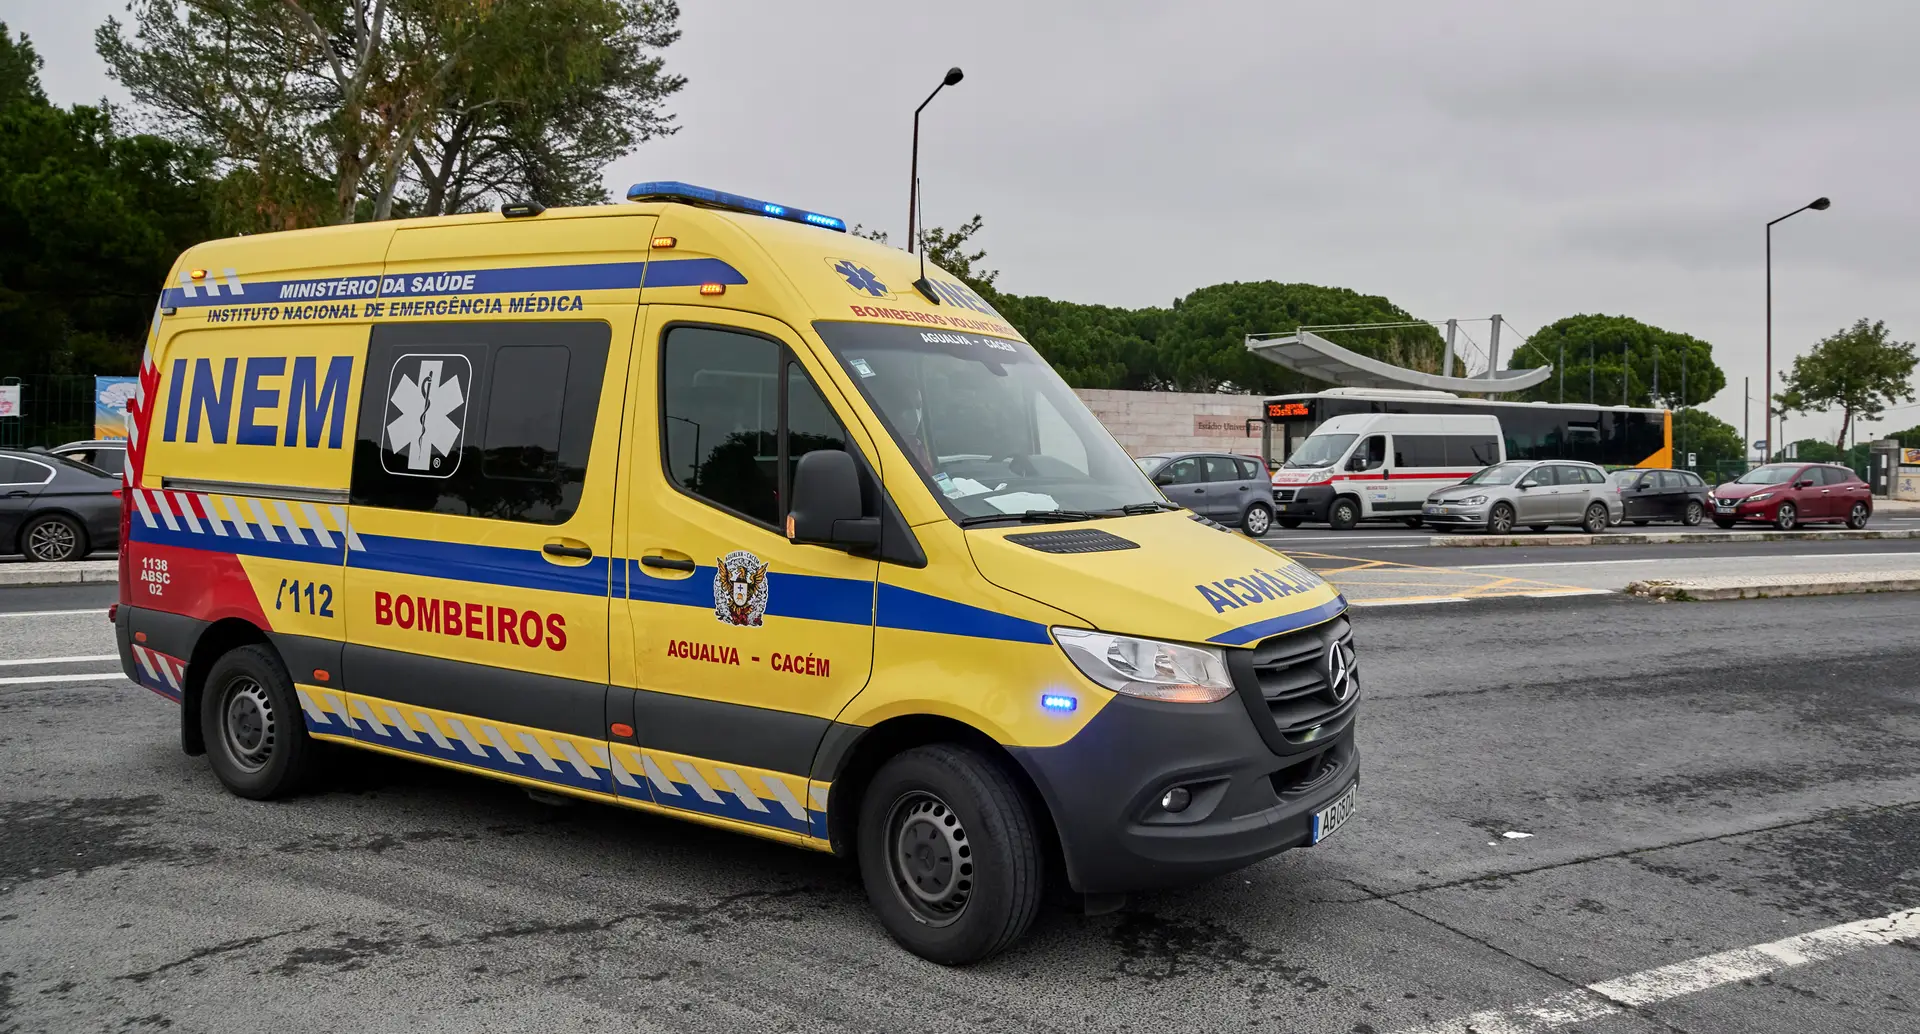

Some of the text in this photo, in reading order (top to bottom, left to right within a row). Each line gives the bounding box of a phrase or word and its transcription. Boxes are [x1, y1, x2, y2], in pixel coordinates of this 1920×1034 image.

[280, 273, 475, 298] MINISTÉRIO DA SAÚDE
[929, 278, 1001, 319] INE
[207, 293, 583, 322] INSTITUTO NACIONAL DE EMERGÊNCIA MÉDICA
[850, 305, 947, 325] BOMBEIROS
[920, 333, 972, 346] AGUALVA
[163, 356, 354, 449] INEM
[140, 570, 171, 584] ABSC
[142, 557, 168, 571] 1138
[149, 583, 163, 596] 02
[289, 580, 334, 618] 112
[375, 591, 567, 651] BOMBEIROS
[668, 640, 740, 666] AGUALVA
[771, 653, 830, 677] CACÉM
